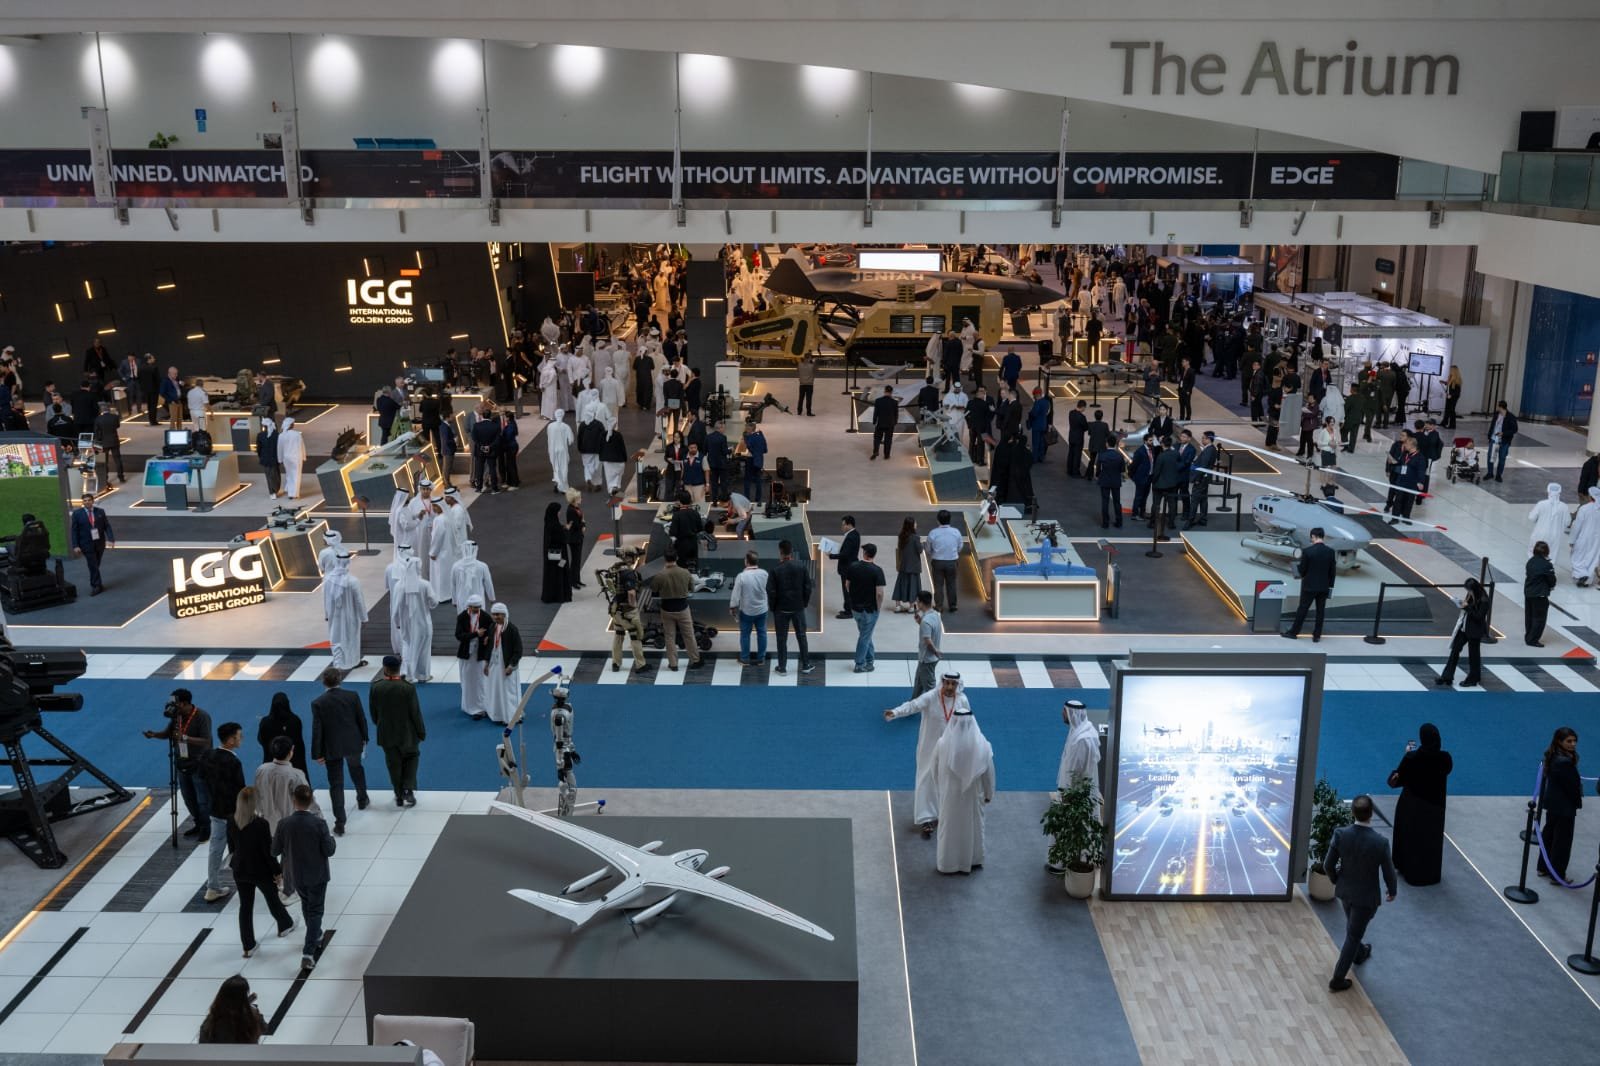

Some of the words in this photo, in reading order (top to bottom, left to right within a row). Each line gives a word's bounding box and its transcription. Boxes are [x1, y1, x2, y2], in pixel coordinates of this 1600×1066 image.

[1110, 41, 1227, 96] The
[1240, 40, 1460, 96] Atrium
[46, 164, 178, 182] UNMNNED.
[182, 165, 319, 182] UNMATCHD.
[580, 166, 652, 183] FLIGHT
[656, 166, 756, 184] WITHOUT
[761, 166, 831, 184] LIMITS.
[836, 167, 964, 185] ADVANTAGE
[1073, 166, 1223, 185] COMPROMISE.
[1270, 166, 1335, 184] EDGE
[347, 279, 413, 305] IGG
[350, 308, 412, 316] INTERNATIONAL
[350, 316, 384, 324] GOLDEN
[385, 316, 413, 324] GROUP
[173, 546, 263, 592] IGG
[176, 584, 263, 607] INTERNATIONAL
[177, 601, 223, 618] GOLDEN
[226, 594, 264, 608] GROUP
